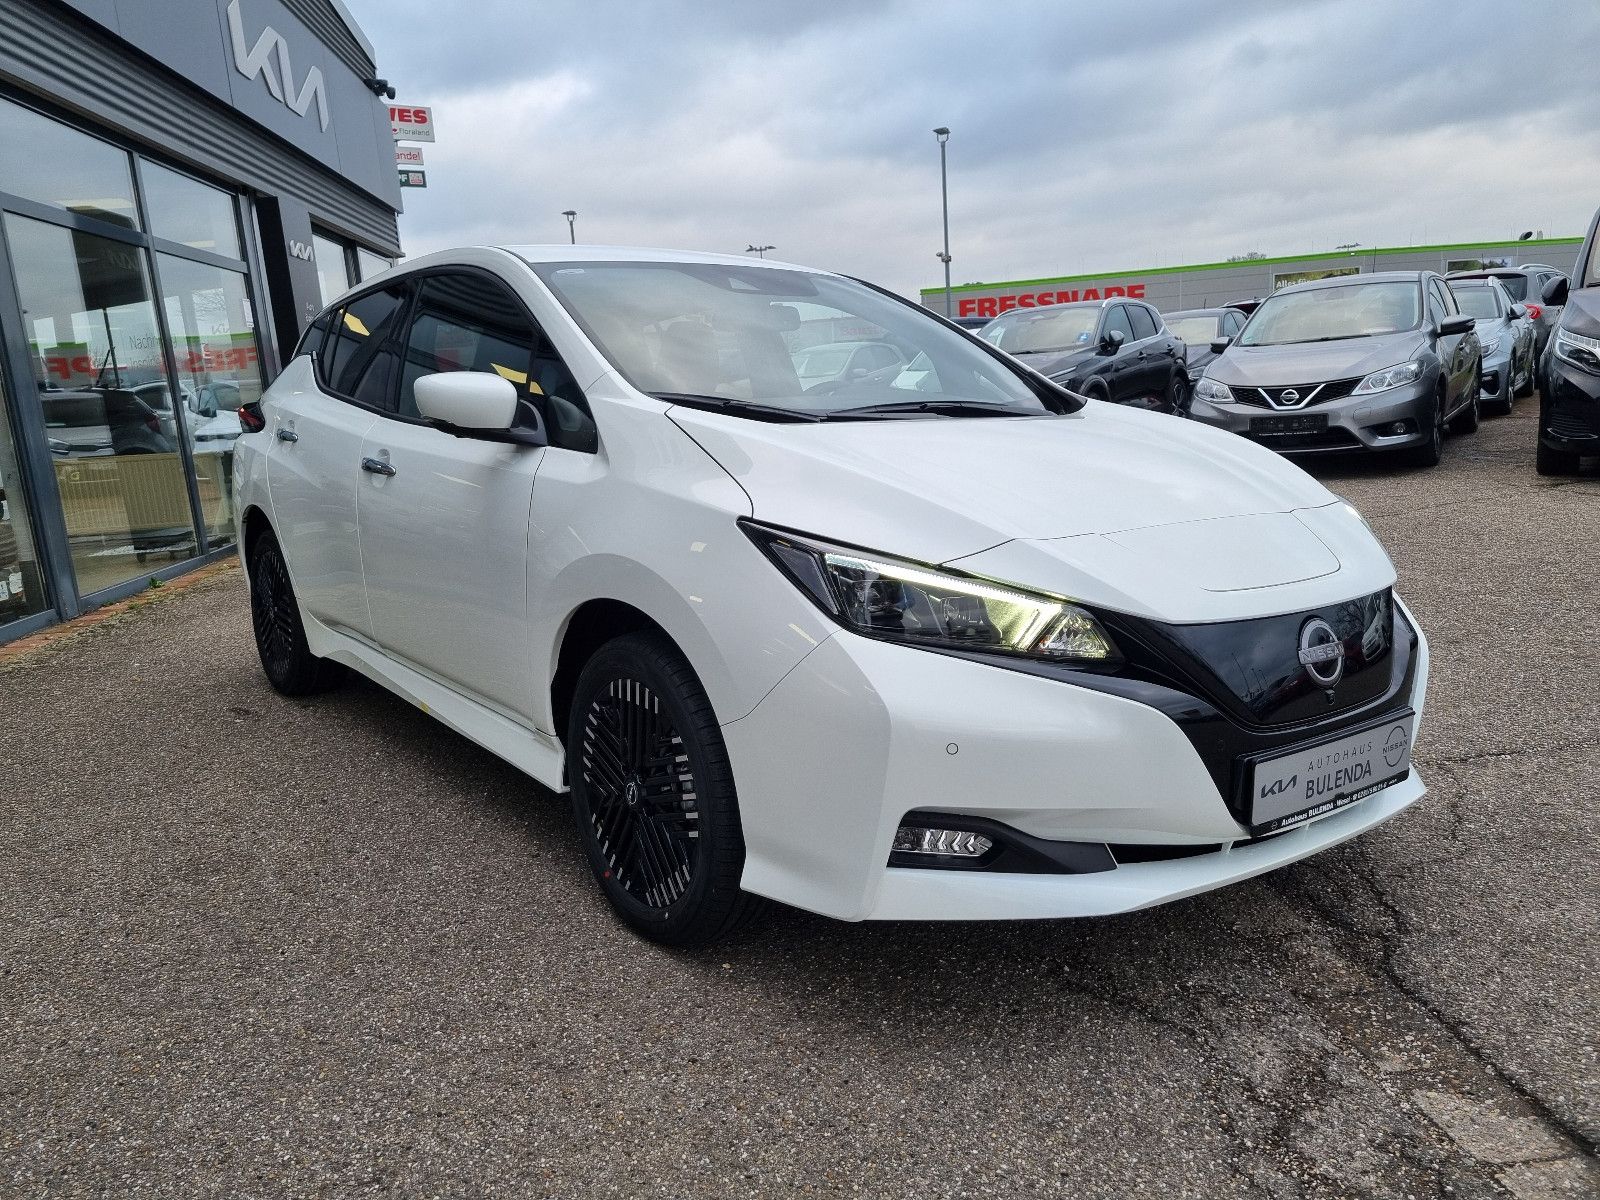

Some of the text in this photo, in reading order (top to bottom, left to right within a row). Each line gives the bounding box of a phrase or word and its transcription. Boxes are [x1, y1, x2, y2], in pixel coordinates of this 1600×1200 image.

[226, 0, 328, 133] KIA
[289, 239, 313, 261] KIA
[1302, 643, 1344, 662] NISSAN
[1307, 741, 1373, 772] AUTOHAUS
[1382, 738, 1409, 755] NISSAN
[1260, 774, 1298, 799] KIA
[1305, 760, 1373, 799] BULENDA
[1281, 811, 1309, 827] Autohaus
[1308, 801, 1334, 818] BULENDA
